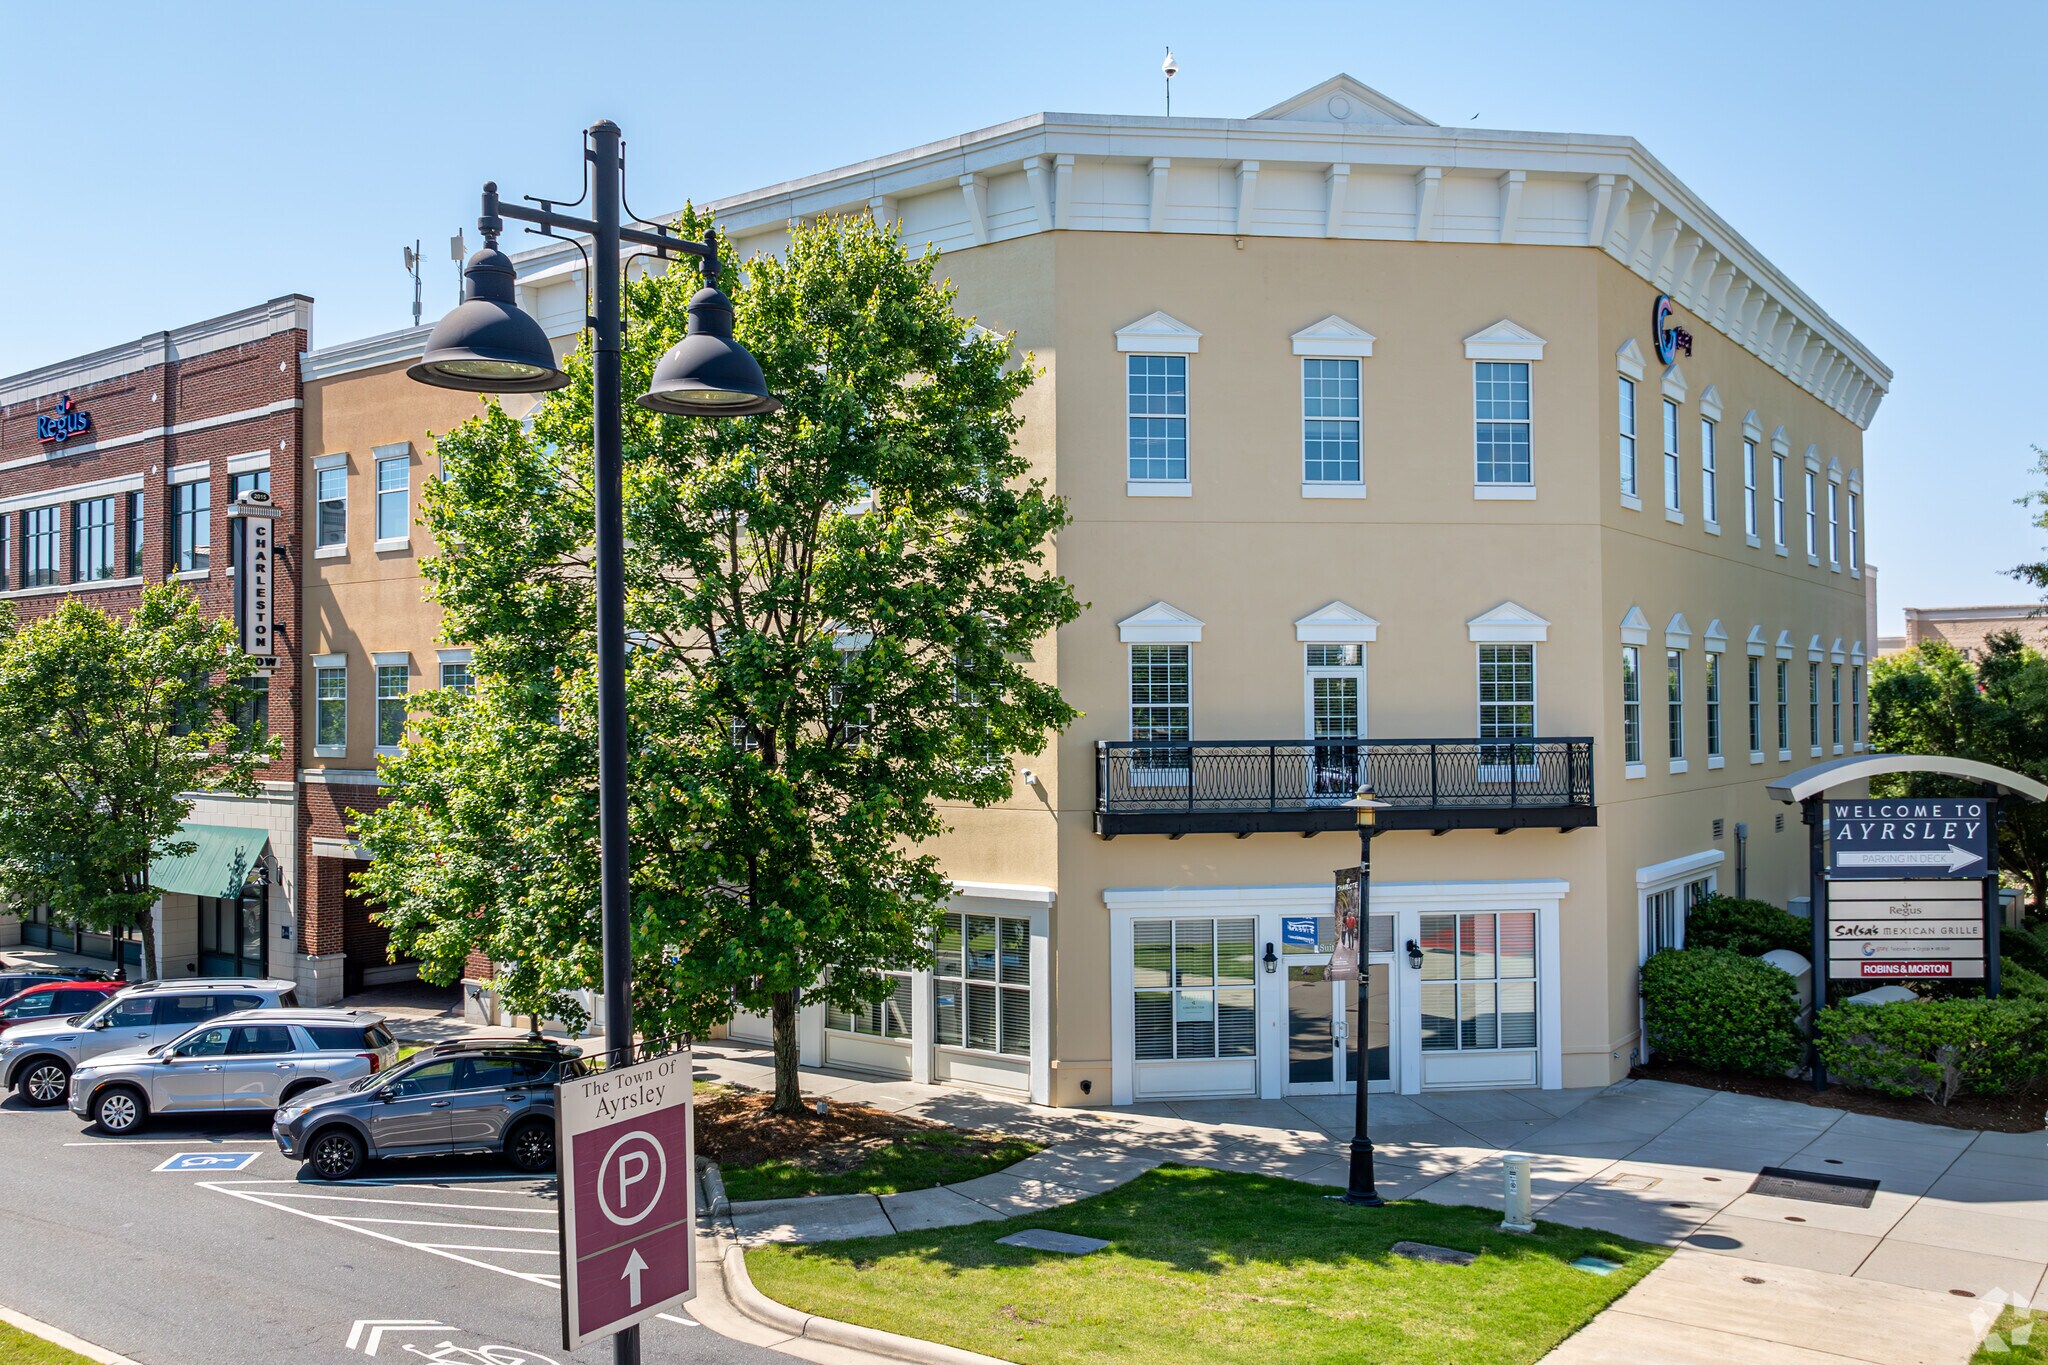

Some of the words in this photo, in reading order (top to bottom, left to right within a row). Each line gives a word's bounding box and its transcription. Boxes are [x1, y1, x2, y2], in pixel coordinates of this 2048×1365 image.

[37, 411, 90, 442] Regus
[255, 526, 267, 648] CHARLESTON
[254, 657, 277, 667] OW
[1835, 805, 1942, 818] WELCOME
[1955, 804, 1981, 817] TO
[1836, 822, 1981, 840] AYRSLEY
[1862, 854, 1905, 864] PARKING
[1906, 854, 1917, 863] IN
[1919, 853, 1947, 863] DECK
[1889, 905, 1922, 917] Regus
[1834, 925, 1879, 937] Salsa's
[1883, 927, 1936, 936] MEXICAN
[1941, 926, 1978, 935] GRILLE
[1863, 964, 1899, 974] ROBINS
[1900, 964, 1908, 973] &
[1908, 964, 1949, 973] MORTON
[582, 1081, 610, 1098] The
[615, 1069, 653, 1089] Town
[658, 1059, 677, 1077] Of
[595, 1084, 666, 1119] Ayrsley
[618, 1150, 649, 1209] P
